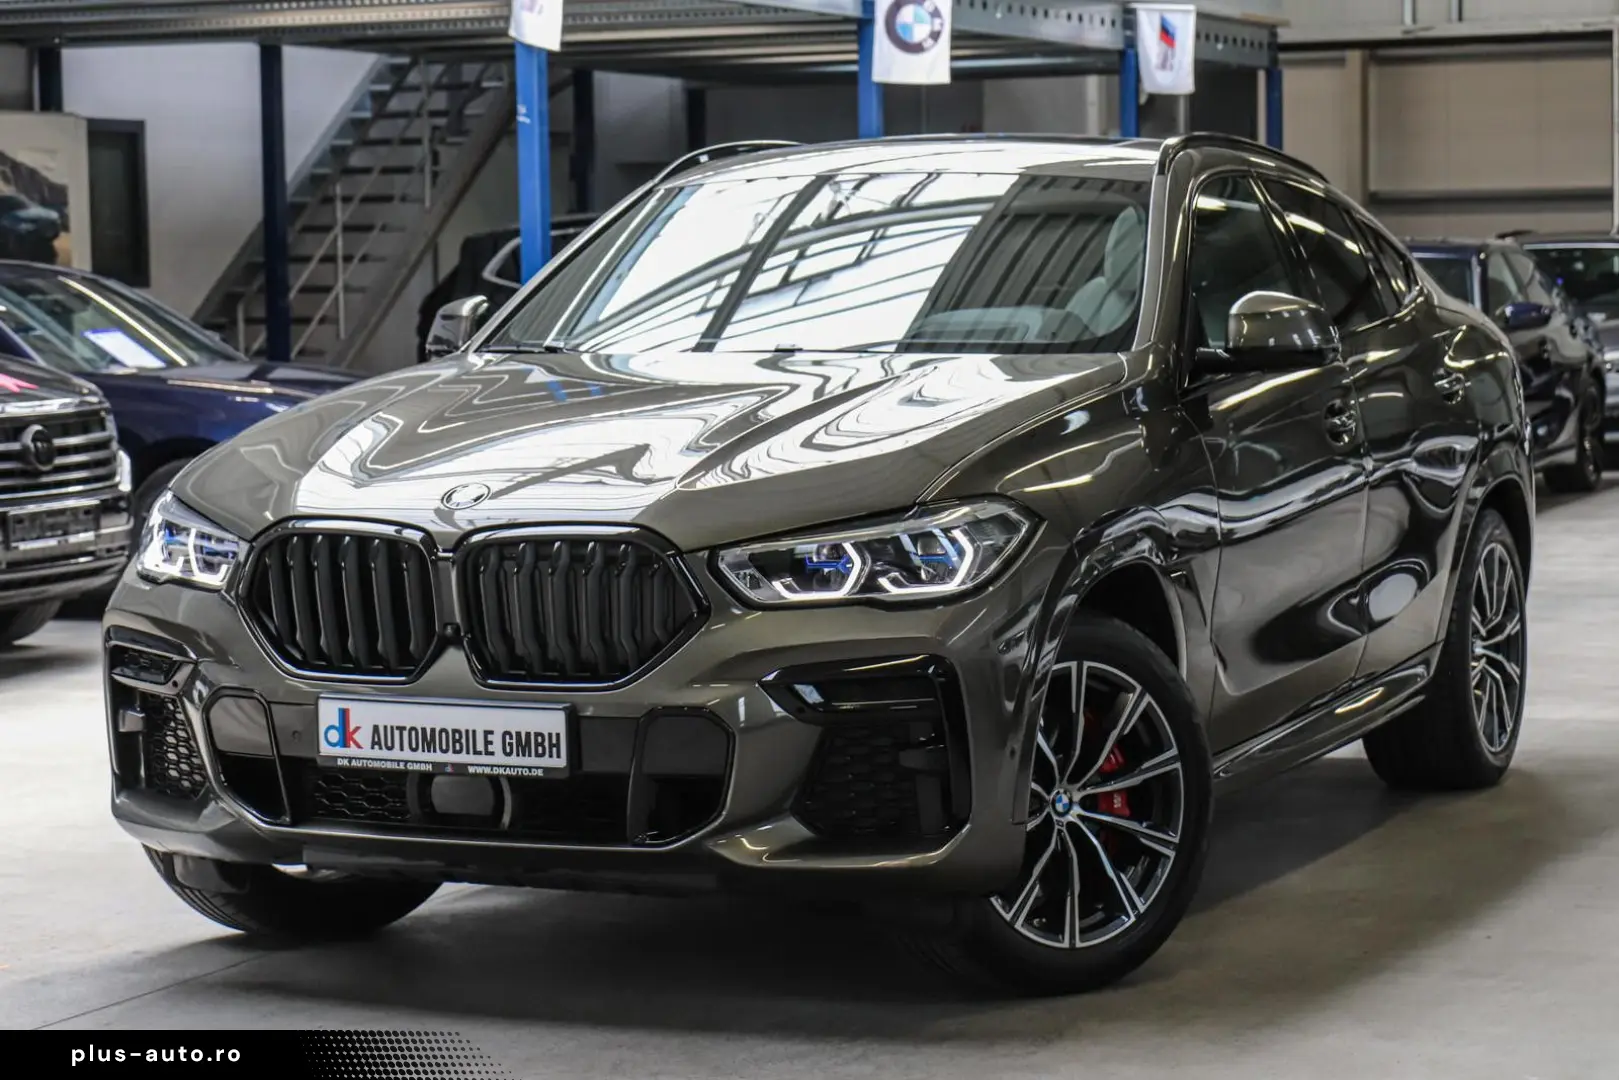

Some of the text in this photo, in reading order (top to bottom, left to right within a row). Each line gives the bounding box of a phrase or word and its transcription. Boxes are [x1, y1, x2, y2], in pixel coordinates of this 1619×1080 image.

[324, 707, 561, 759] dk AUTOMOBILE GMBH
[337, 758, 433, 772] DK AUTOMOBILE GMBH
[467, 765, 544, 777] WWW.DKAUTO.DE
